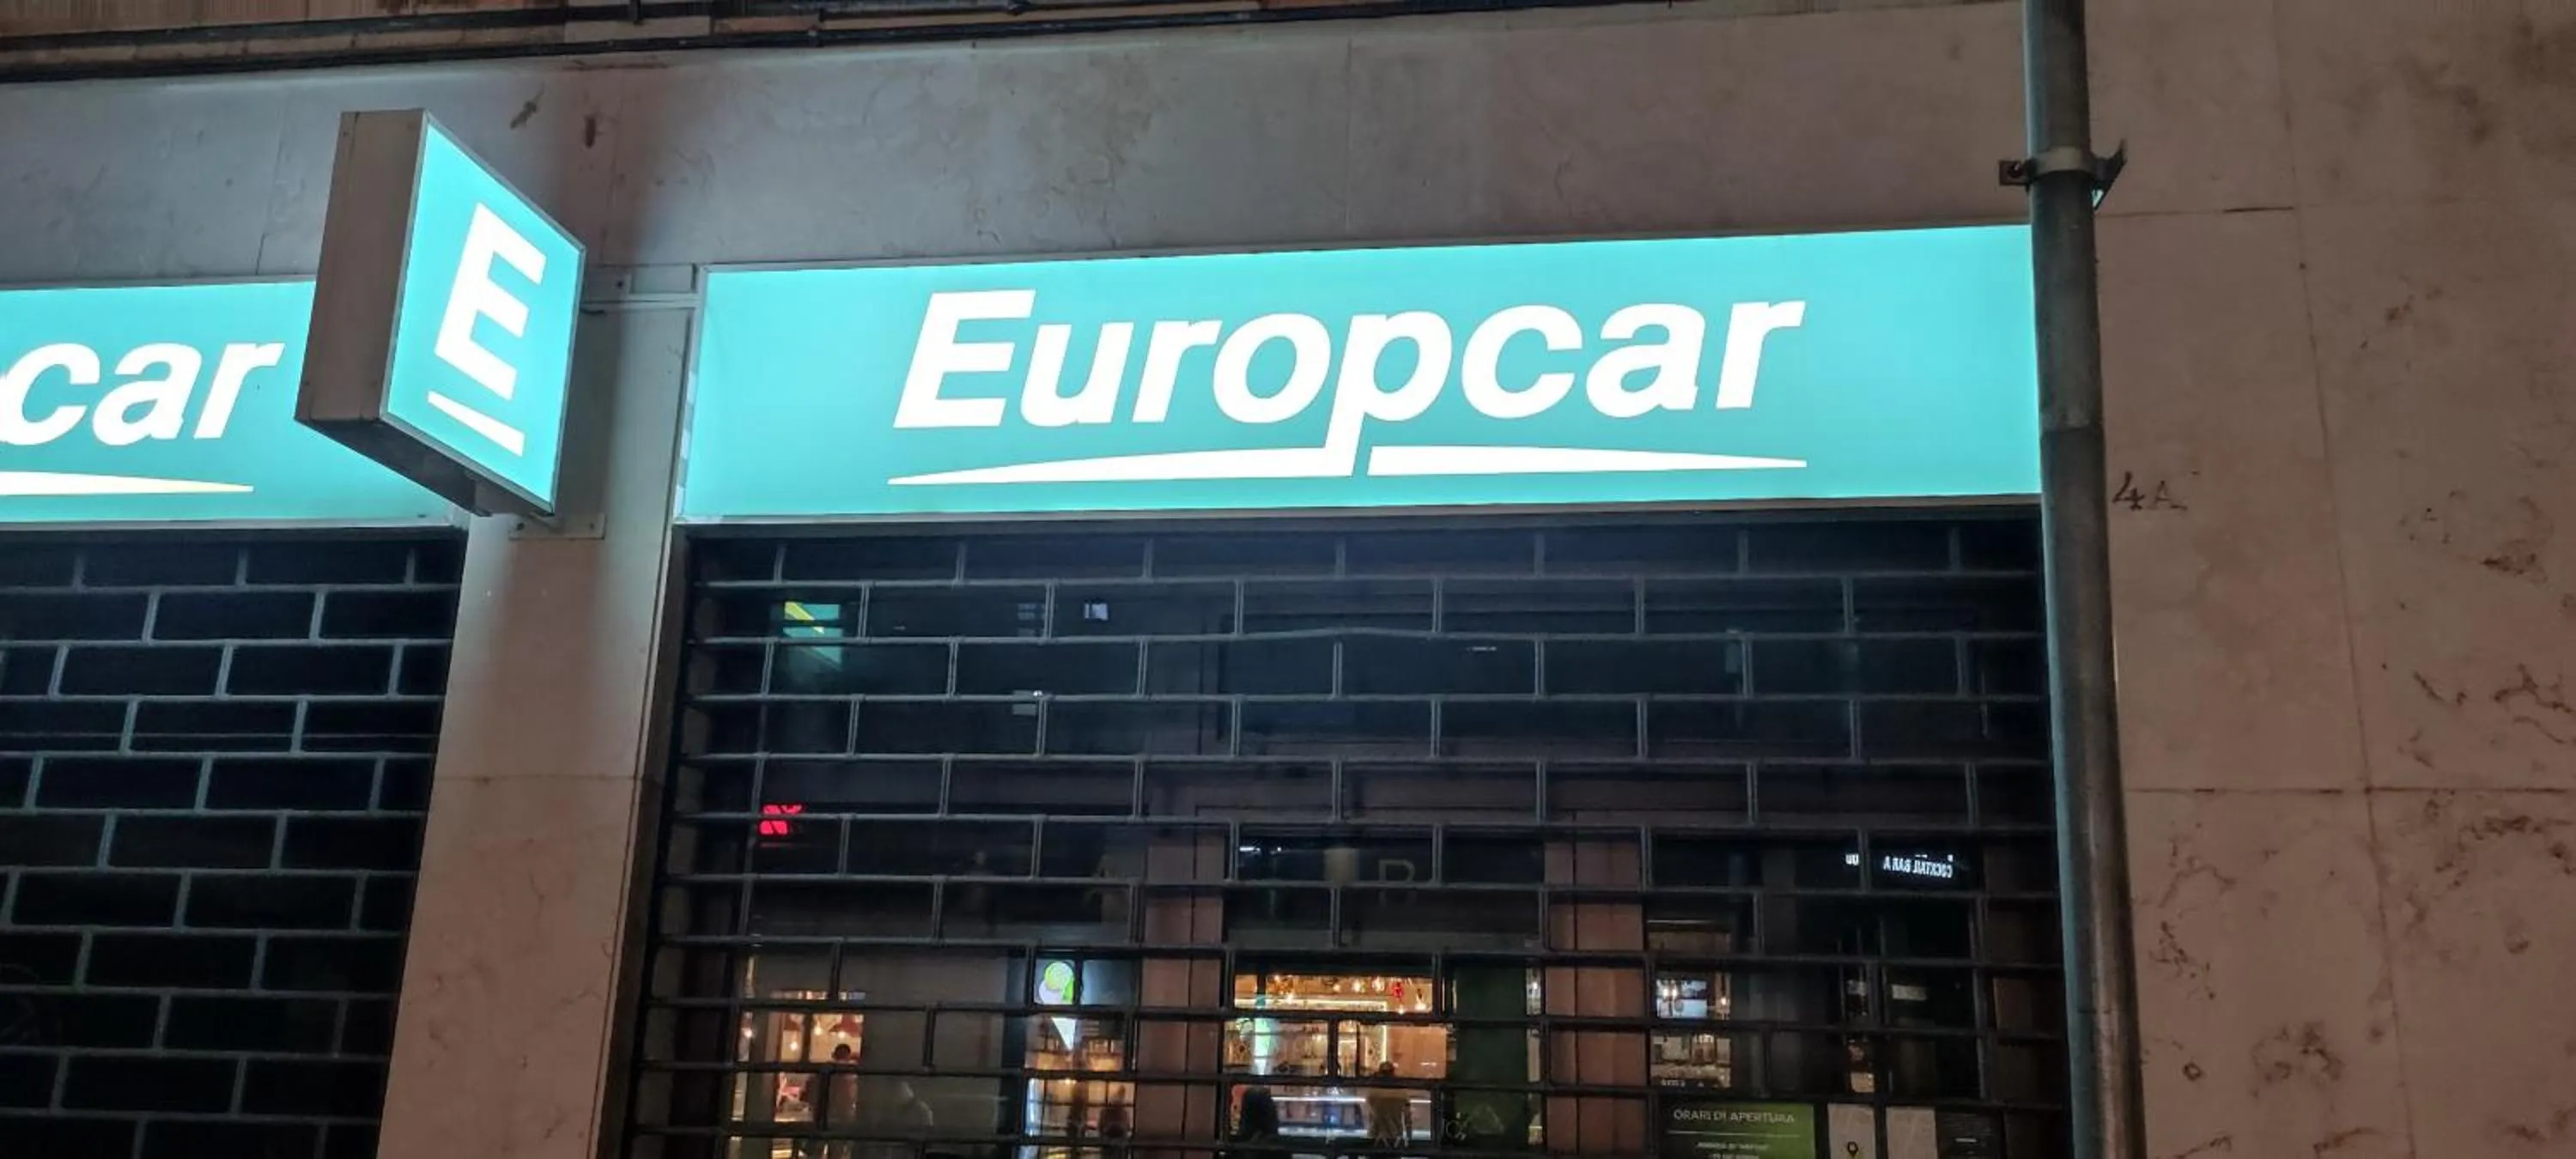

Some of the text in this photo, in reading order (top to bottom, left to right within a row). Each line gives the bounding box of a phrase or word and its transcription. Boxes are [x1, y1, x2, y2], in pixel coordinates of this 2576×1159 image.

[436, 204, 546, 400] E
[0, 343, 285, 445] car
[893, 290, 1805, 476] Europcar
[1673, 1107, 1795, 1124] ORARI DI APERTURA
